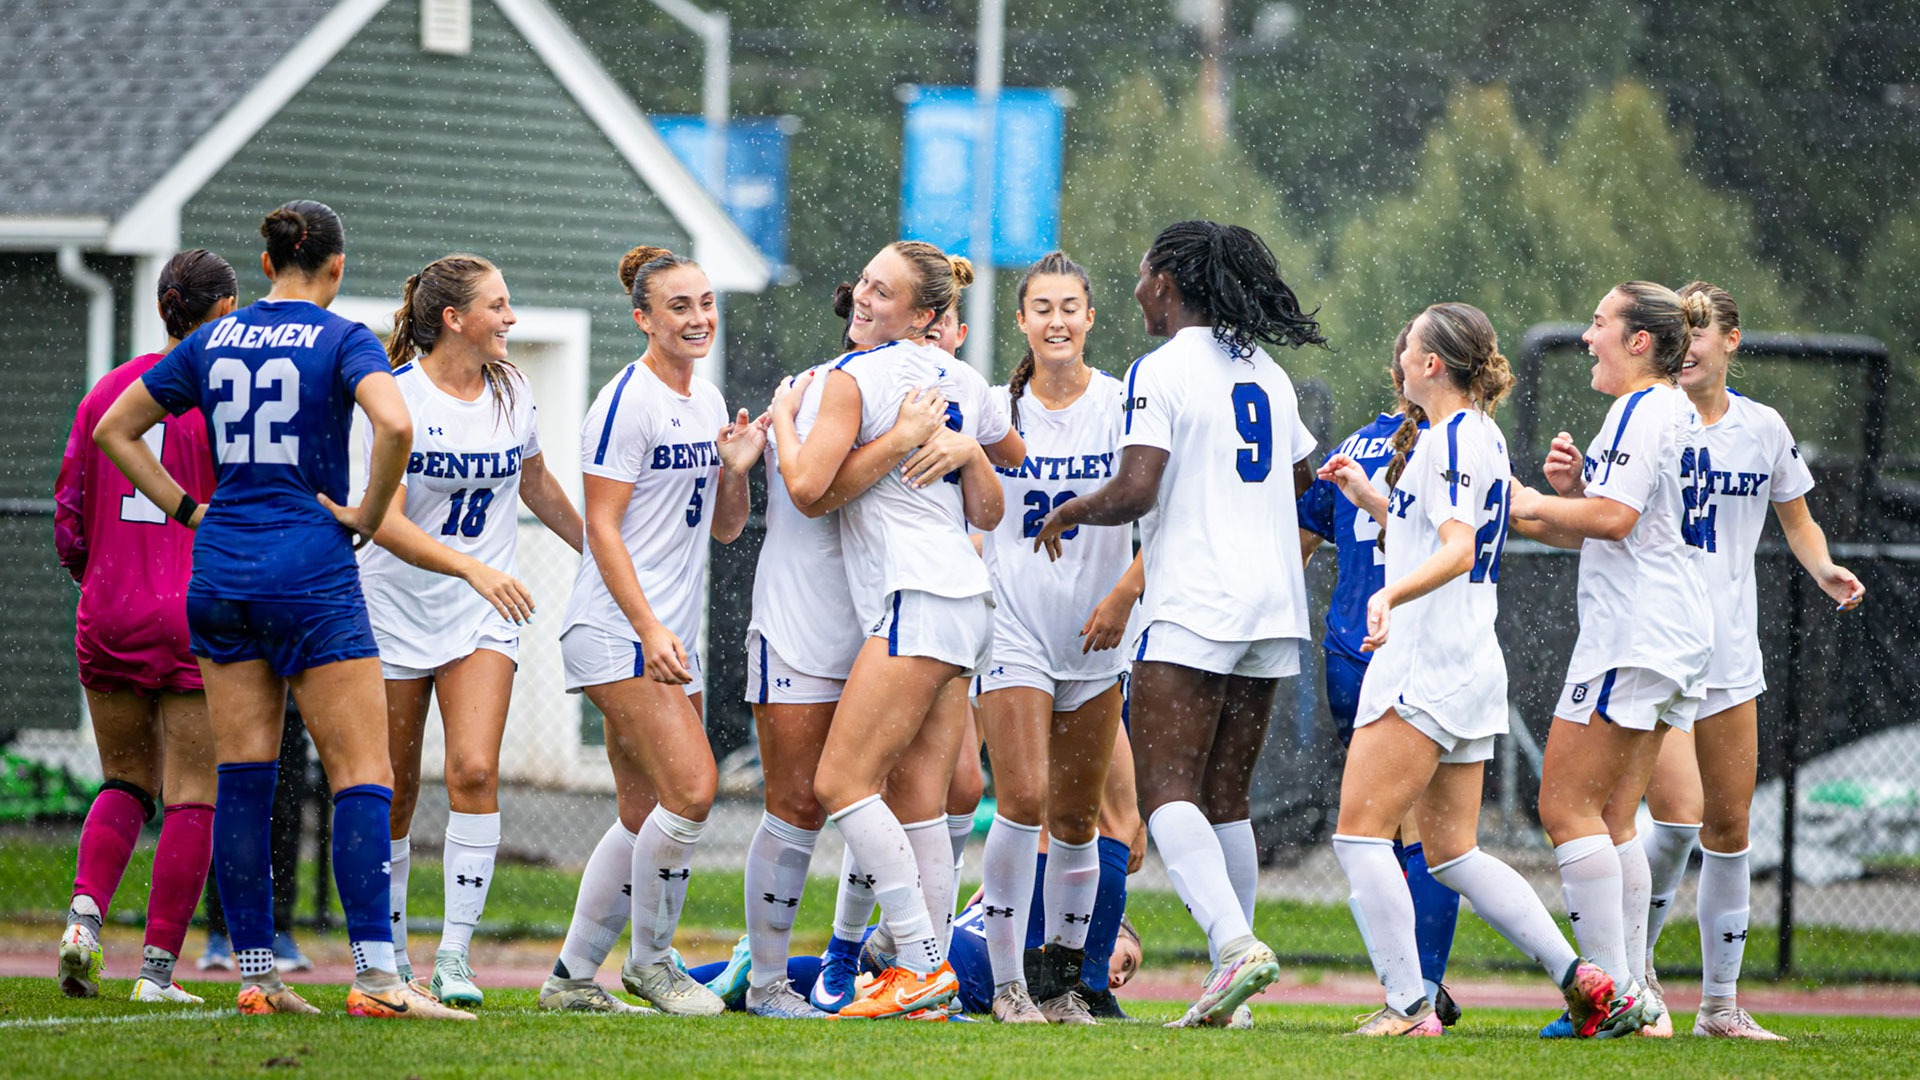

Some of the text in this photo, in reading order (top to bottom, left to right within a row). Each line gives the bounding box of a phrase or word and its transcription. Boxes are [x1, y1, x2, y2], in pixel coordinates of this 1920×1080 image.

[205, 316, 324, 350] DAEMEN
[208, 357, 300, 466] 22
[1231, 381, 1273, 483] 9
[1340, 433, 1396, 460] DAEM
[406, 444, 524, 479] BENTLEY
[650, 440, 720, 470] BENTL
[995, 452, 1114, 480] NTLEY
[1708, 470, 1769, 497] TLEY
[440, 488, 495, 538] 18
[685, 476, 707, 528] 5
